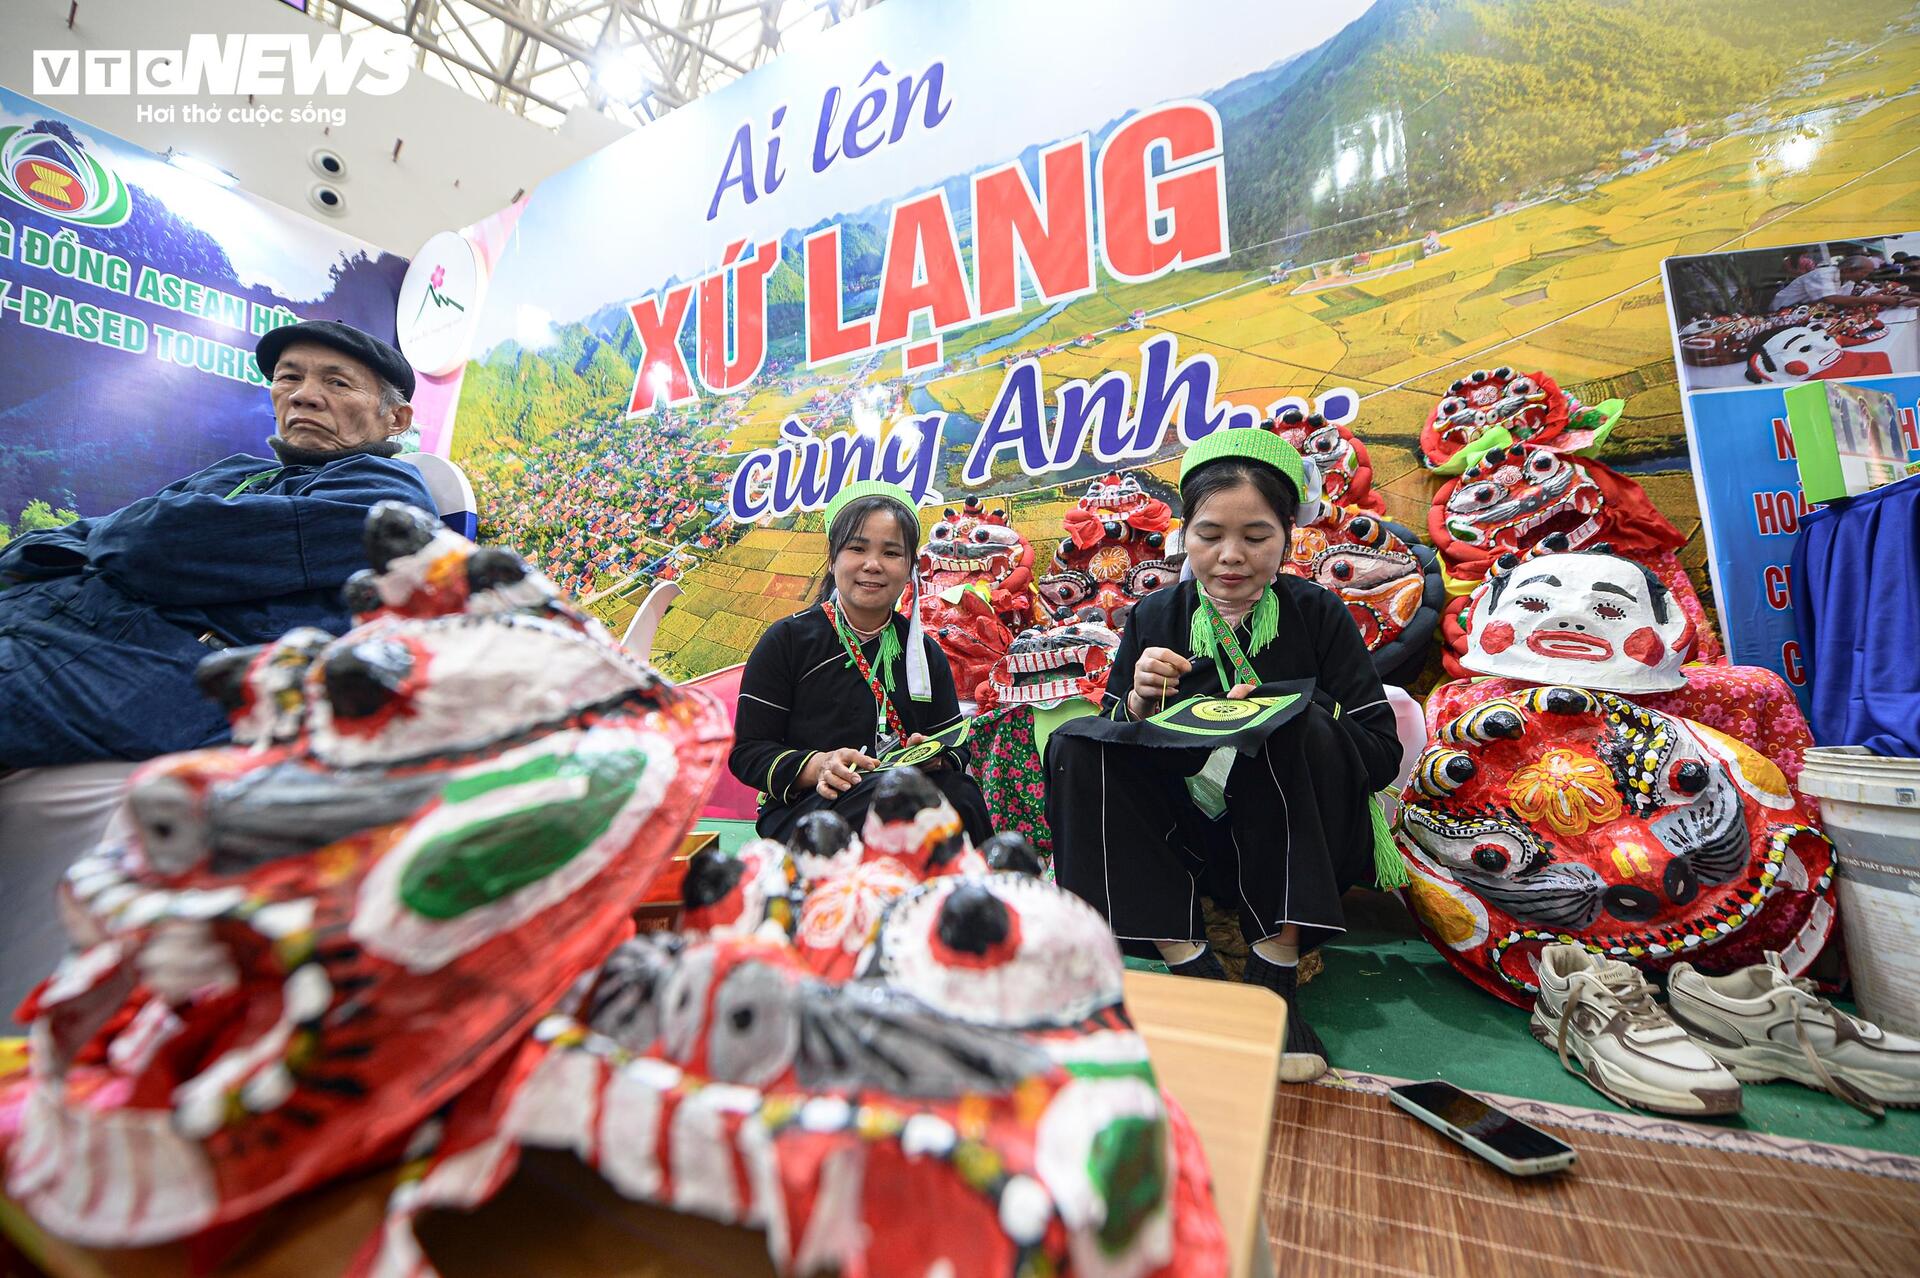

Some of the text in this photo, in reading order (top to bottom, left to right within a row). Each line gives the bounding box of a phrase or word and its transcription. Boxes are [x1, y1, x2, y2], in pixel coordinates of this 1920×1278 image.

[706, 61, 952, 221] Ai lên
[21, 227, 130, 294] ĐỒNG
[137, 267, 245, 330] ASEAN
[629, 102, 1230, 416] XỨ LẠNG
[154, 325, 271, 387] TOURIS
[730, 414, 946, 521] cùng
